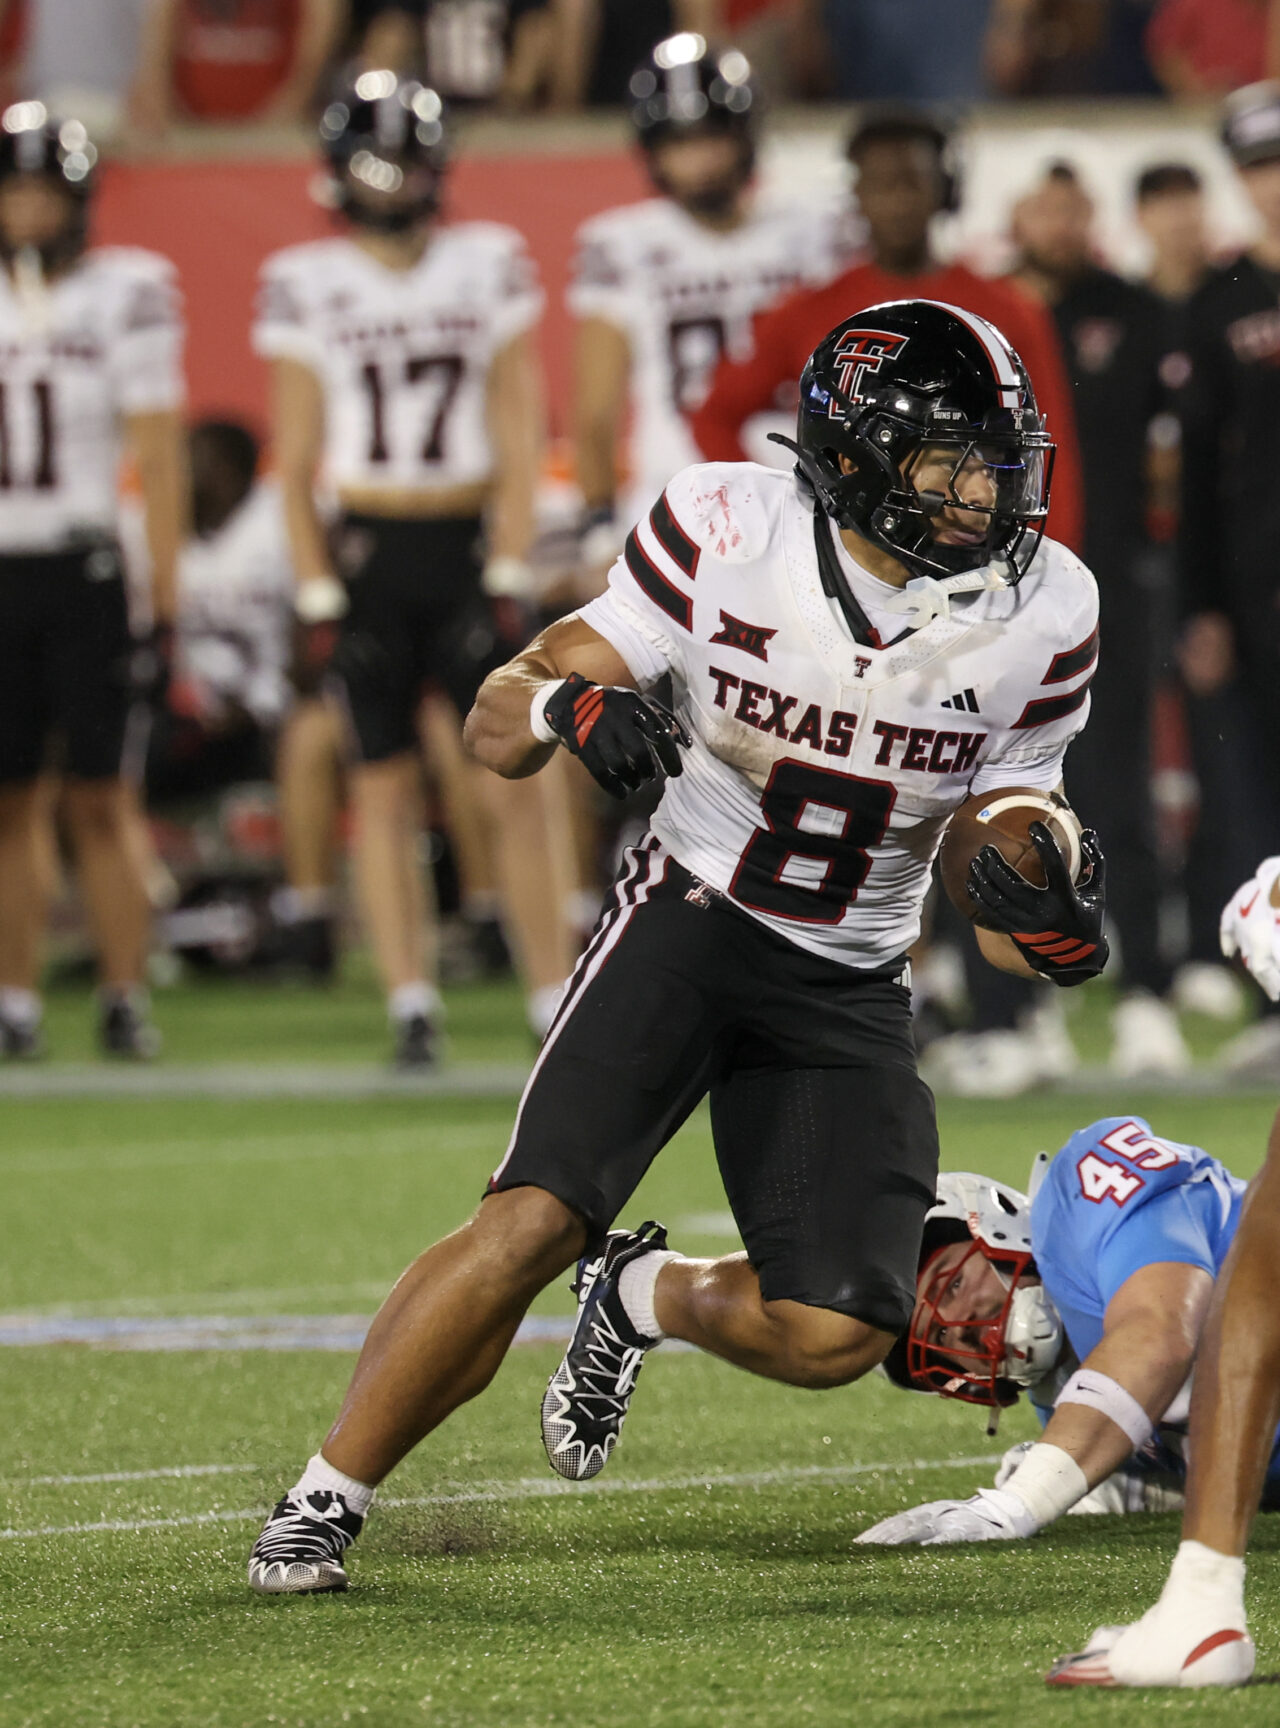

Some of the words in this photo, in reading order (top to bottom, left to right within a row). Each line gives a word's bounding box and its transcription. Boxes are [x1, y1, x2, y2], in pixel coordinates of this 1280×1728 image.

[362, 354, 466, 463] 17
[933, 411, 951, 420] GUNS
[952, 412, 963, 421] UP
[709, 665, 858, 757] TEXAS
[873, 720, 988, 774] TECH
[728, 756, 898, 925] 8
[1076, 1121, 1179, 1208] 45
